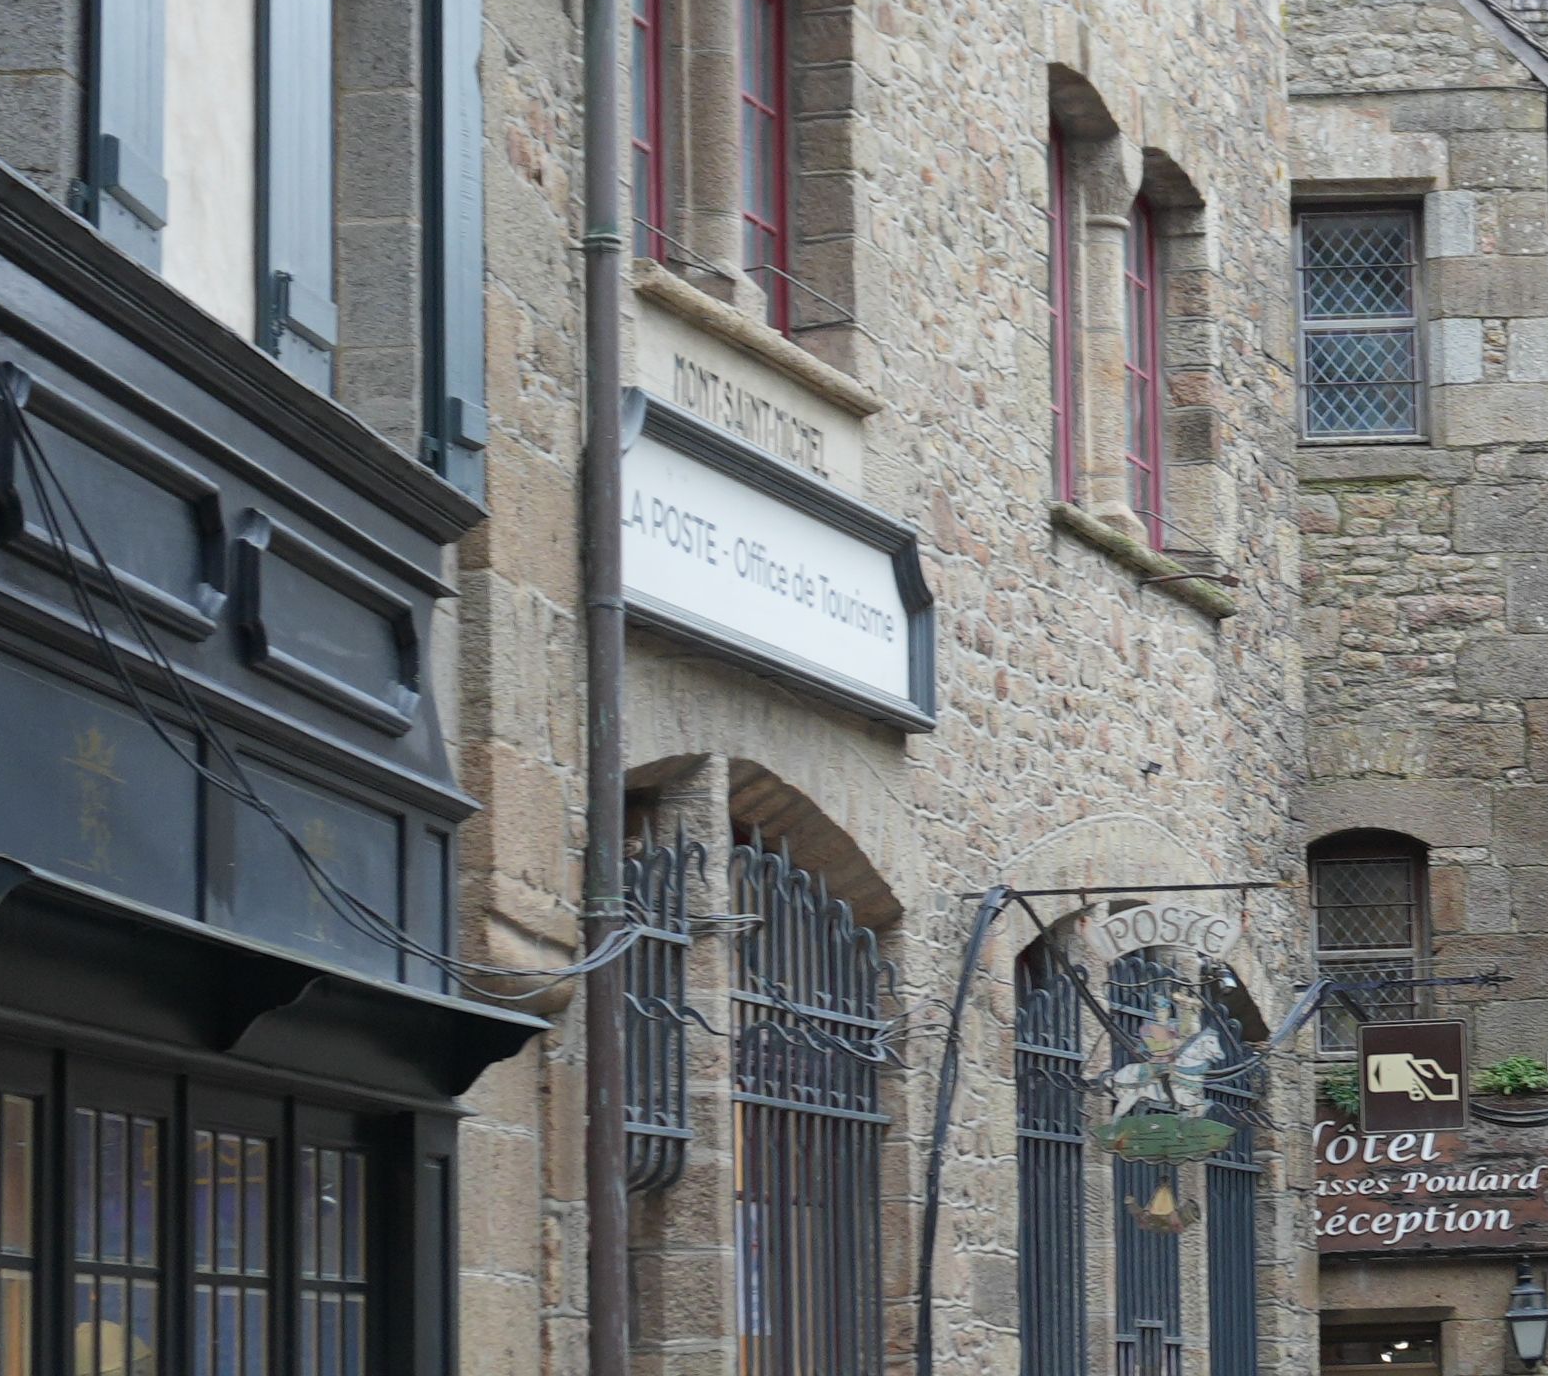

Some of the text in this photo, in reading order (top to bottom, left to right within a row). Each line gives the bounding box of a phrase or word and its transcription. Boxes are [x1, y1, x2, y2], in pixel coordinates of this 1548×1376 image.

[652, 497, 716, 565] POSTE
[734, 537, 788, 596] Office
[792, 562, 815, 608] de
[818, 574, 894, 643] Tourisme
[1101, 907, 1231, 954] POSTE
[1314, 1165, 1548, 1196] asses Poulard
